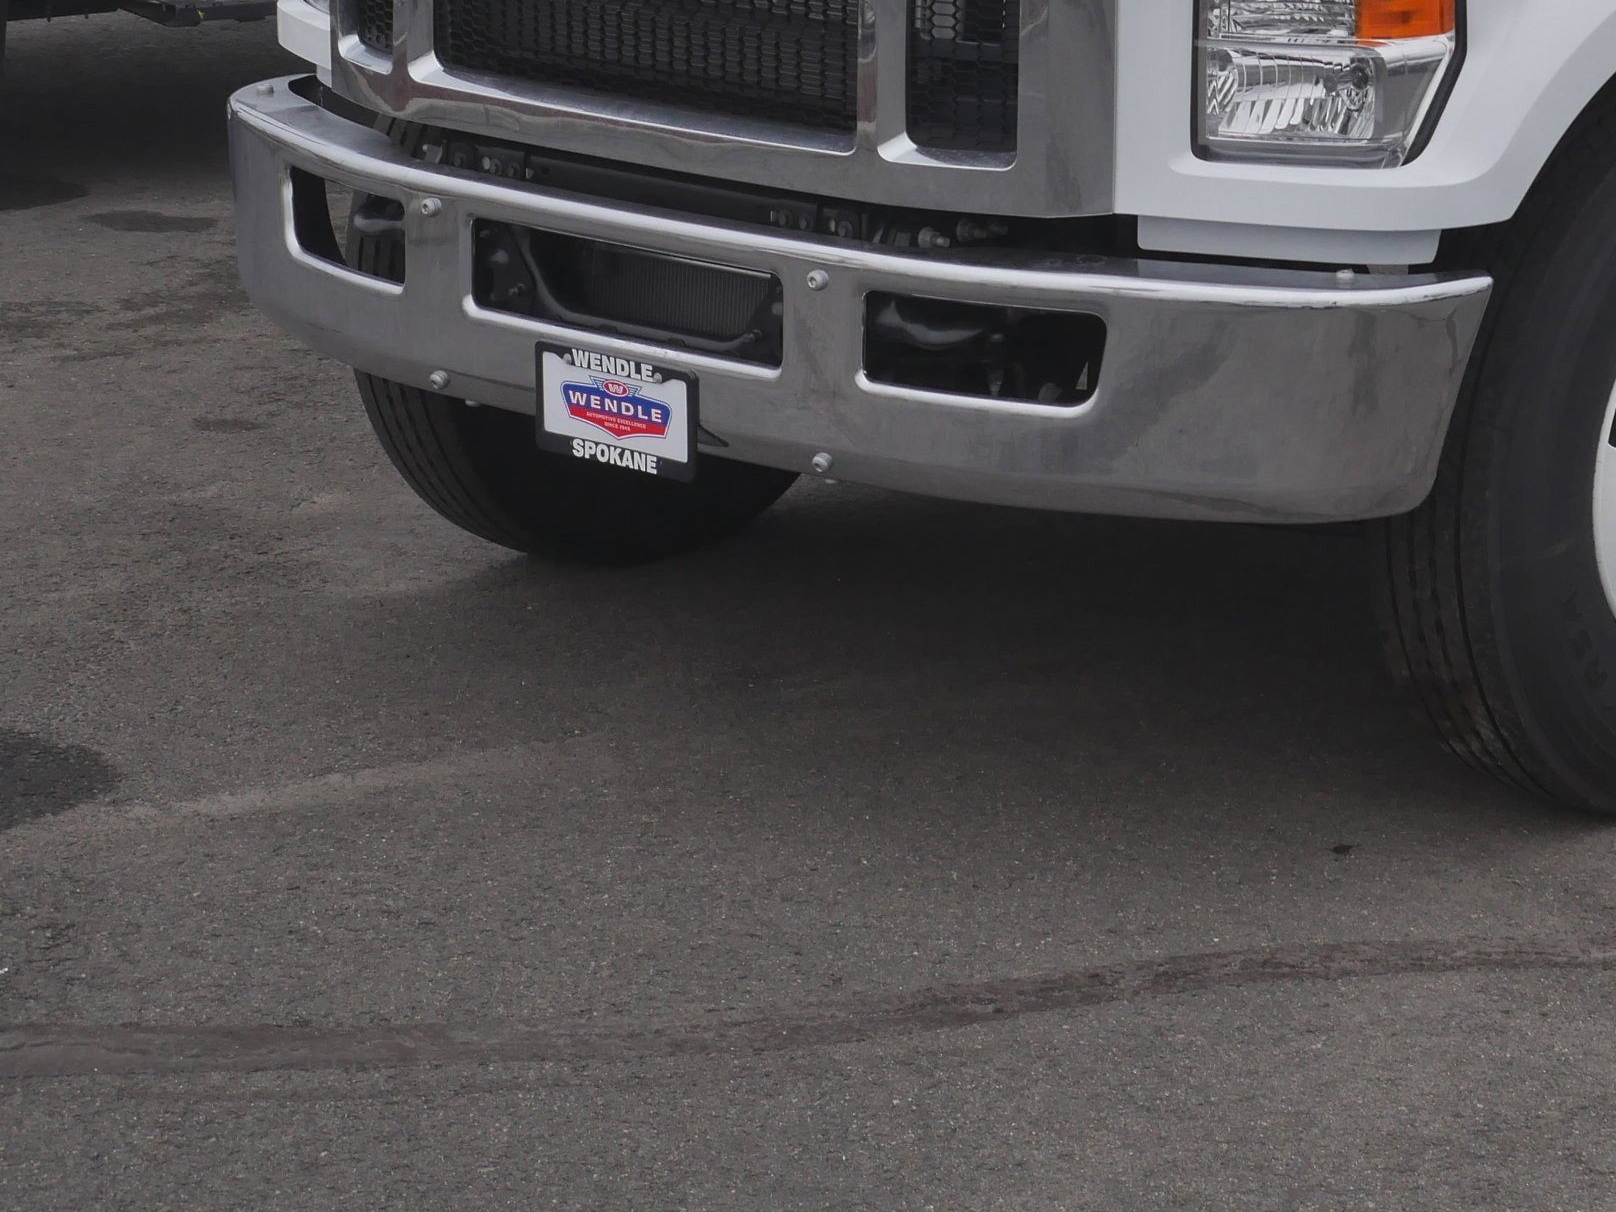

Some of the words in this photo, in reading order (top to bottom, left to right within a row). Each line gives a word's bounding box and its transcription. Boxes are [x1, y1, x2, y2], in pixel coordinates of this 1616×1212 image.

[571, 348, 654, 383] WENDLE
[568, 390, 662, 423] WENDLE
[572, 438, 658, 475] SPOKANE
